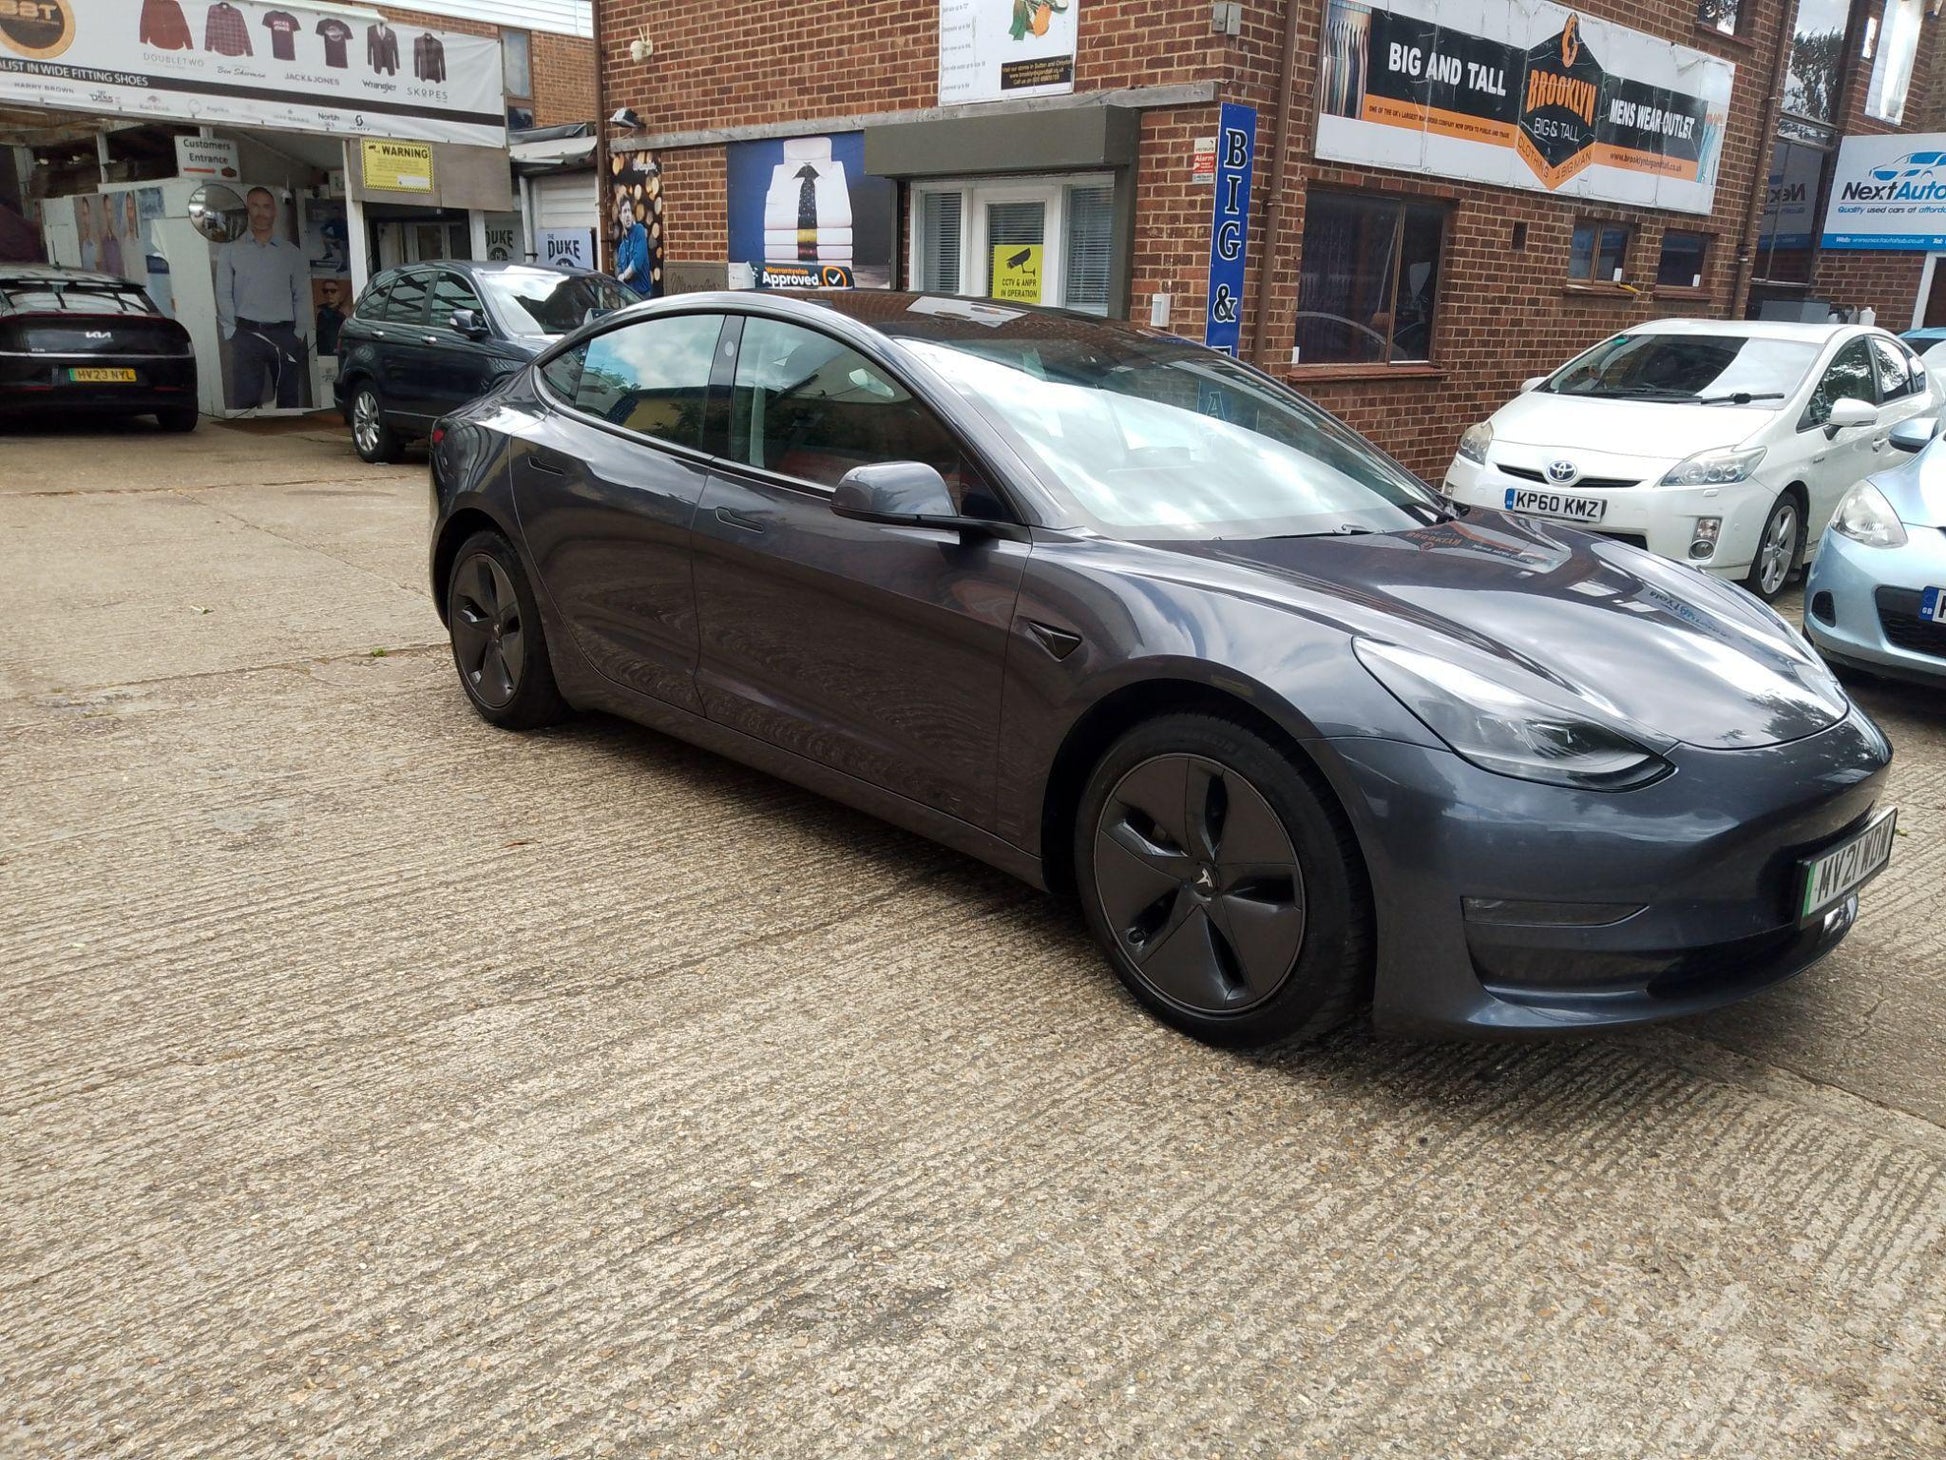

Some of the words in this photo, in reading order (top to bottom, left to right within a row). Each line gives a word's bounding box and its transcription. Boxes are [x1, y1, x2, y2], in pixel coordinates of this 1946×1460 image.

[27, 63, 39, 73] IN
[39, 65, 70, 78] WIDE
[71, 69, 113, 83] FITTING
[114, 74, 149, 87] SHOES
[1388, 42, 1421, 76] BIG
[1425, 52, 1462, 86] AND
[1467, 61, 1507, 97] TALL
[362, 79, 397, 94] Wrangler
[407, 87, 448, 100] SKOPES
[1526, 69, 1597, 127] BROOKLYN
[318, 112, 340, 121] North
[1608, 98, 1636, 127] MENS
[1637, 105, 1663, 134] WEAR
[1662, 114, 1695, 140] OUTLET
[1533, 117, 1550, 137] BIG
[1549, 122, 1558, 137] &
[1560, 122, 1580, 143] TALL
[183, 138, 231, 150] Customers
[189, 152, 229, 164] Entrance
[382, 145, 428, 159] WARNING
[1838, 205, 1865, 216] Quality
[1866, 205, 1887, 214] used
[1888, 206, 1905, 214] cars
[1907, 206, 1918, 214] at
[547, 240, 580, 260] DUKE
[1002, 278, 1015, 286] CCTV
[1022, 278, 1037, 287] ANPR
[1001, 289, 1006, 297] IN
[1007, 289, 1038, 298] OPERATION
[1213, 283, 1236, 323] &
[77, 370, 109, 380] HV23
[111, 370, 133, 380] NYL
[1515, 491, 1560, 512] KP60
[1563, 498, 1599, 518] KMZ
